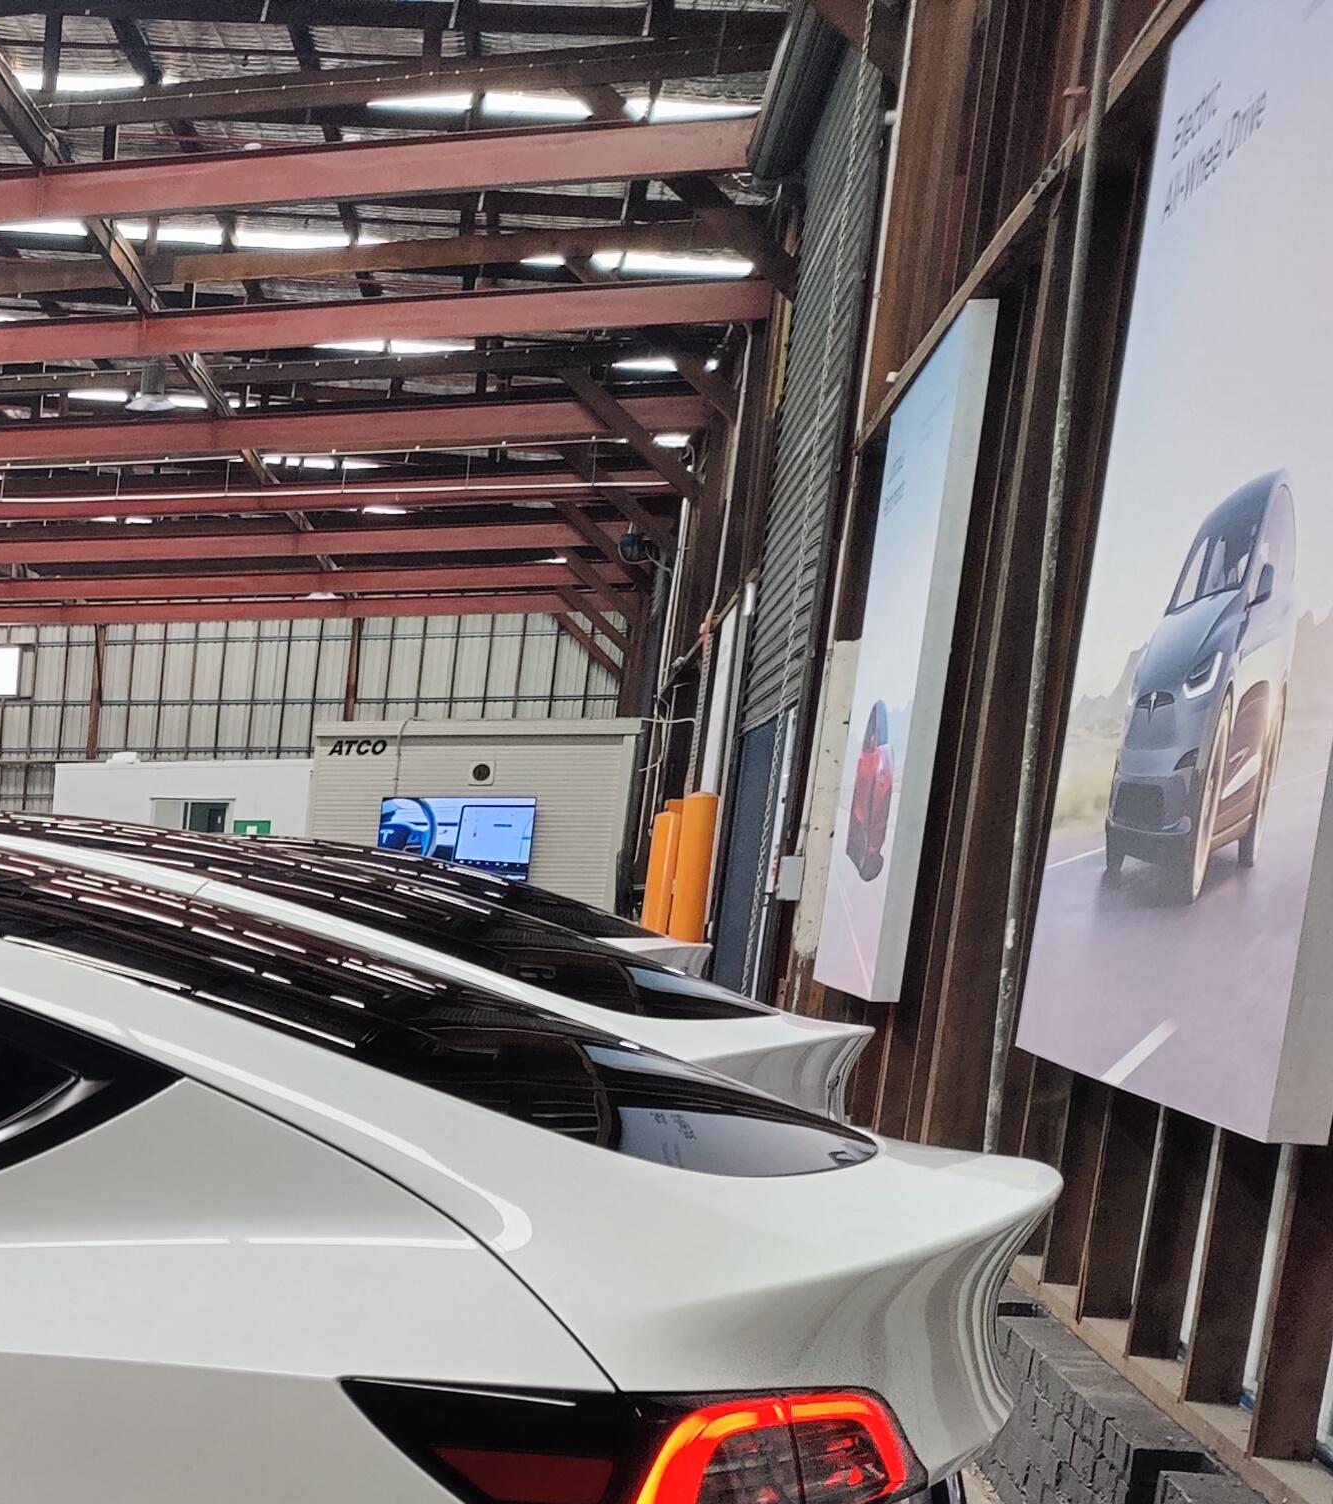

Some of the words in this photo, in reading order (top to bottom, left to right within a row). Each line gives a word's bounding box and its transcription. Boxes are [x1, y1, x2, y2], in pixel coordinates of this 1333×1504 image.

[1172, 77, 1221, 160] Electric
[1227, 91, 1267, 159] Drive
[328, 739, 387, 756] ATCO
